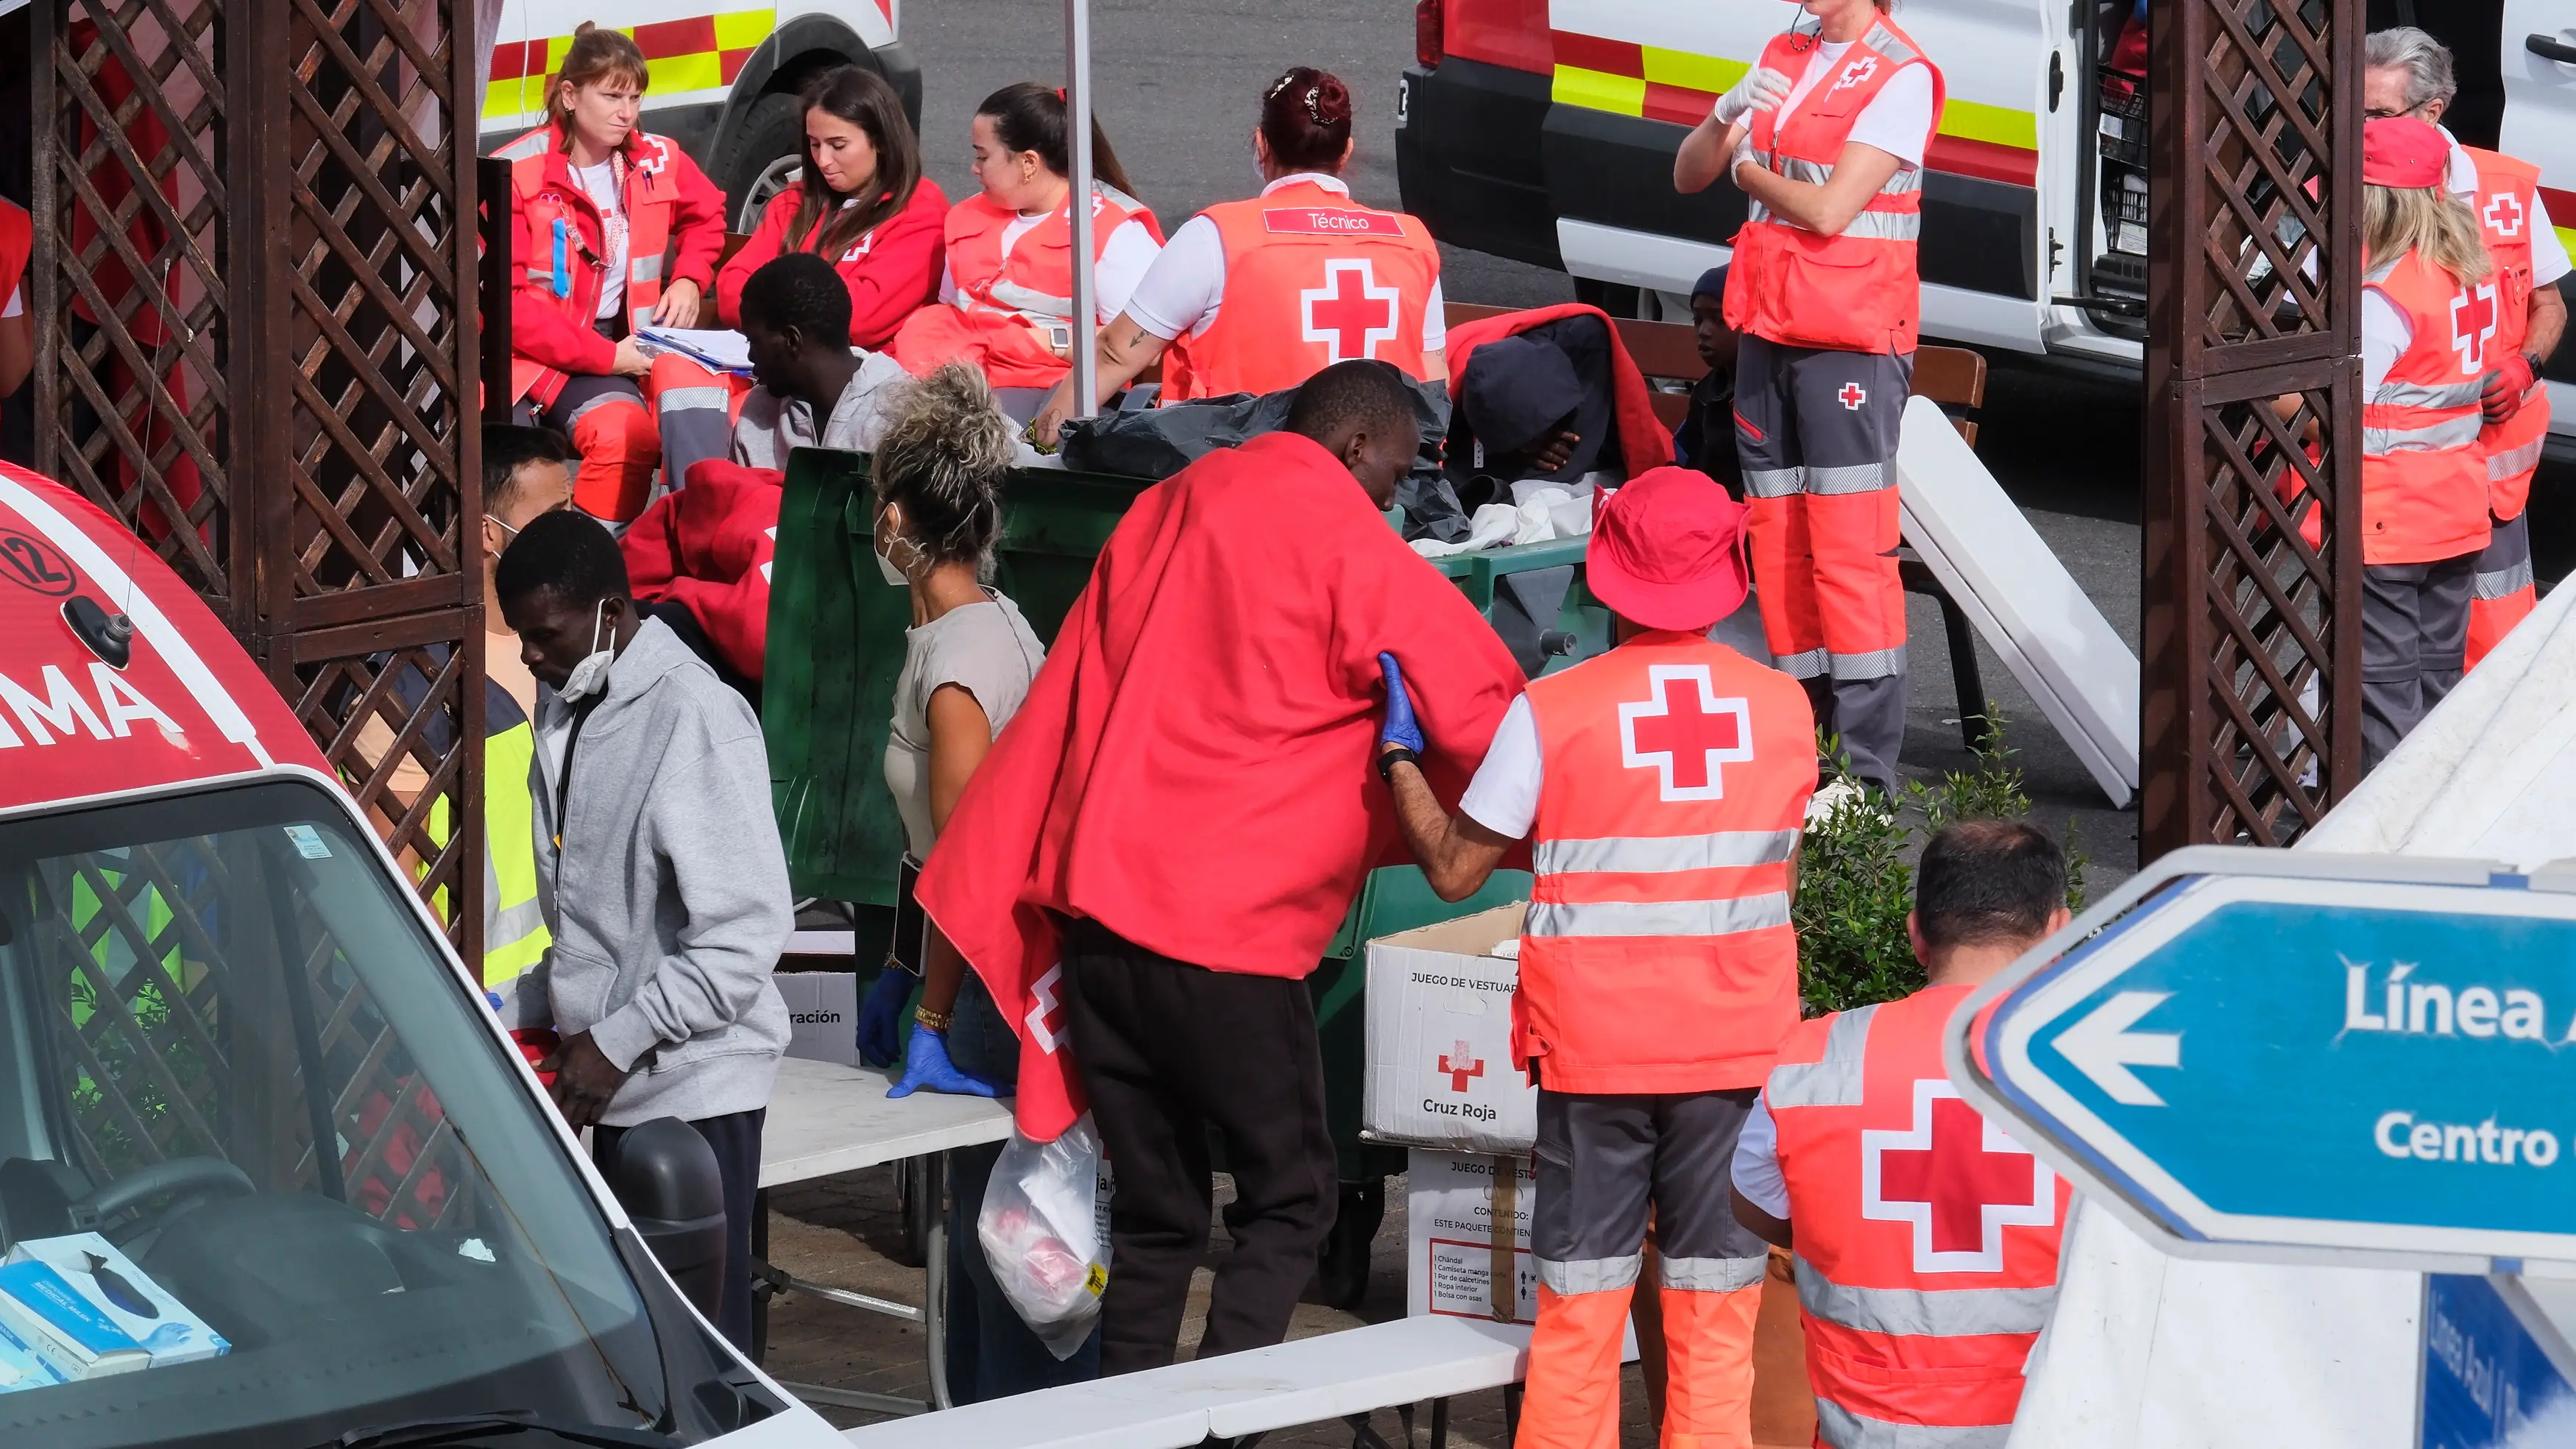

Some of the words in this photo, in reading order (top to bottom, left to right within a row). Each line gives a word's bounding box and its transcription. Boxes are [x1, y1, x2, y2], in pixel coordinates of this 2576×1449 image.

[1307, 213, 1370, 230] Técnico
[0, 536, 68, 584] 12
[0, 662, 185, 749] MA
[1411, 972, 1448, 985] JUEGO
[1451, 977, 1466, 988] DE
[2345, 962, 2544, 1039] Línea
[1423, 1098, 1458, 1116] Cruz
[1462, 1102, 1496, 1122] Roja
[2374, 1110, 2560, 1168] Centro
[1451, 1161, 1485, 1175] JUEGO
[1473, 1206, 1529, 1221] CONTENIDO:
[1434, 1219, 1453, 1228] ESTE
[1455, 1222, 1492, 1233] PAQUETE
[1437, 1255, 1463, 1264] Chándal
[1437, 1264, 1466, 1274] Camiseta
[1468, 1268, 1489, 1278] manga
[1438, 1282, 1454, 1290] Ropa
[1455, 1283, 1478, 1293] interior
[1459, 1275, 1490, 1286] calcetines
[34, 1281, 68, 1307] MEDICAL
[68, 1305, 91, 1322] MASK
[1438, 1291, 1454, 1299] Bolsa
